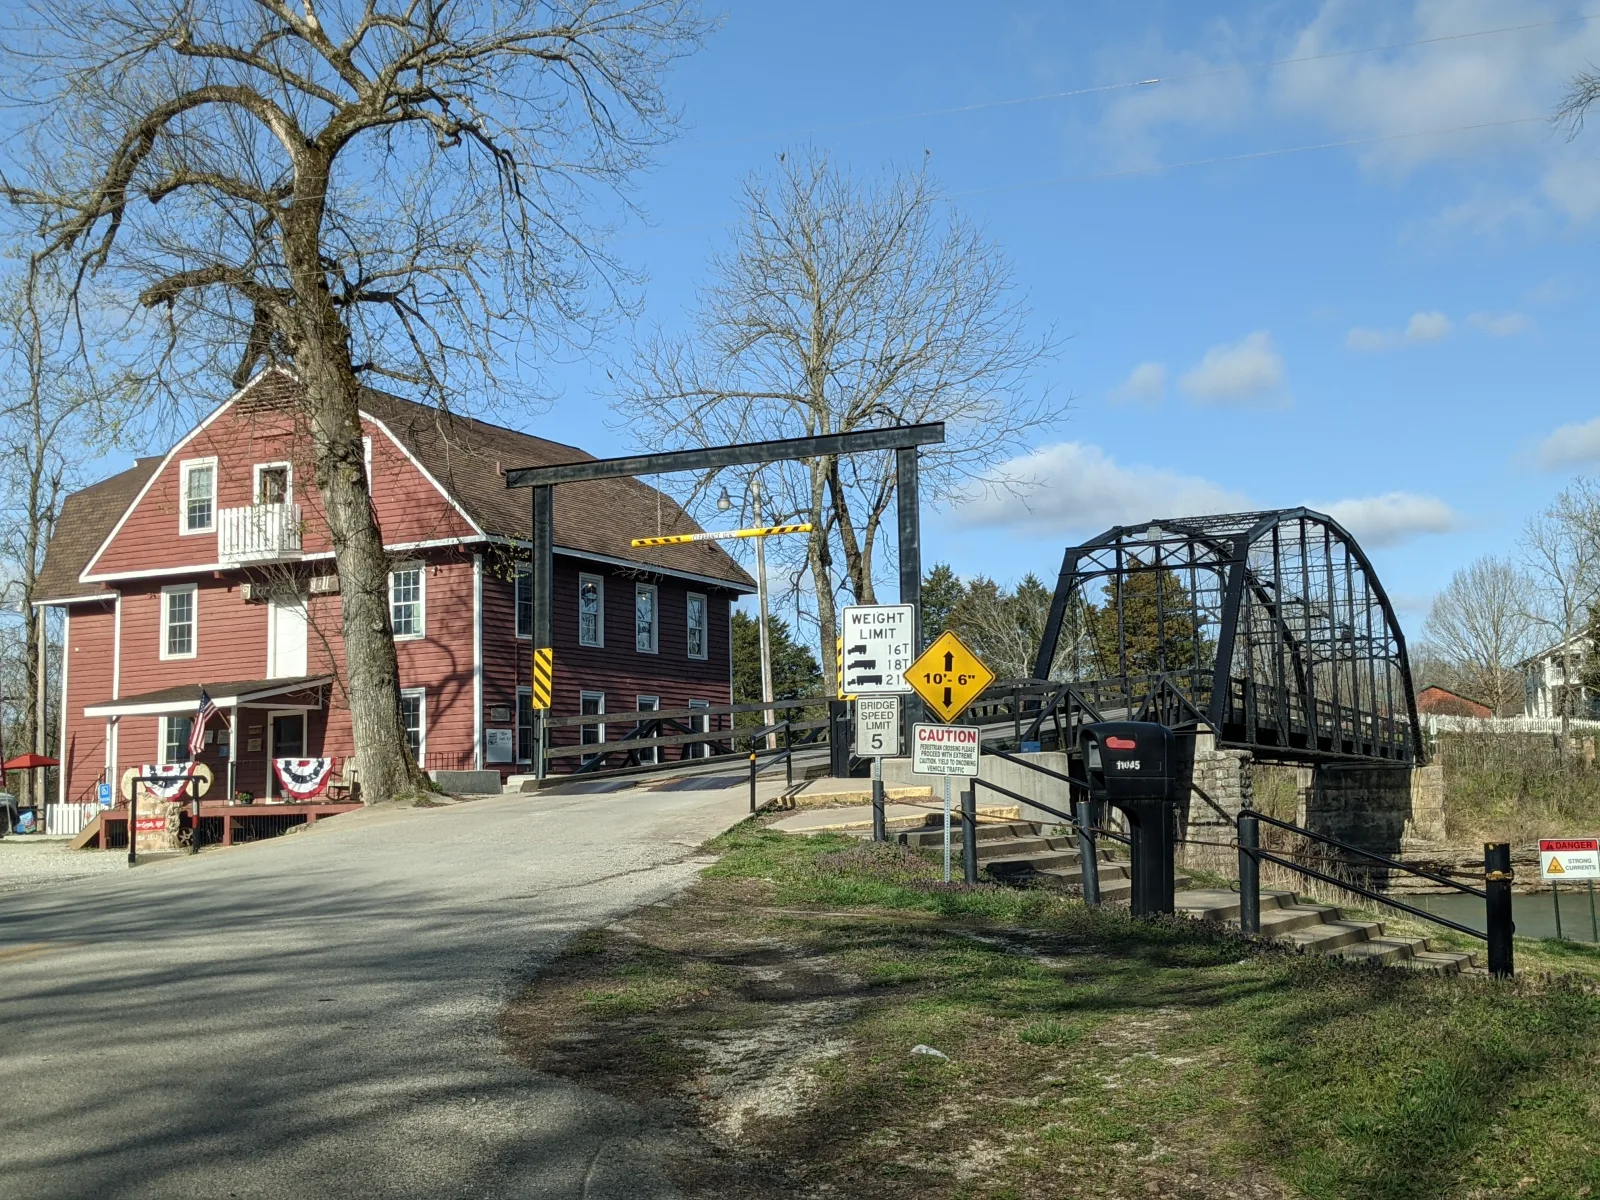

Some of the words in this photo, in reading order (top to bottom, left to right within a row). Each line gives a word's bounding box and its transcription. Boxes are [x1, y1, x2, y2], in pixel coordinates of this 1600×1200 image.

[852, 612, 904, 625] WEIGHT
[860, 628, 896, 640] LIMIT
[888, 643, 909, 655] 16T
[888, 659, 909, 670] 18T
[886, 674, 907, 686] 21
[958, 674, 975, 686] 6"
[861, 701, 895, 710] BRIDGE
[861, 711, 894, 720] SPEED
[866, 721, 891, 730] LIMIT
[871, 733, 883, 749] 5
[919, 728, 976, 743] CAUTION
[1116, 760, 1140, 770] 11045
[1556, 841, 1592, 849] DANGER
